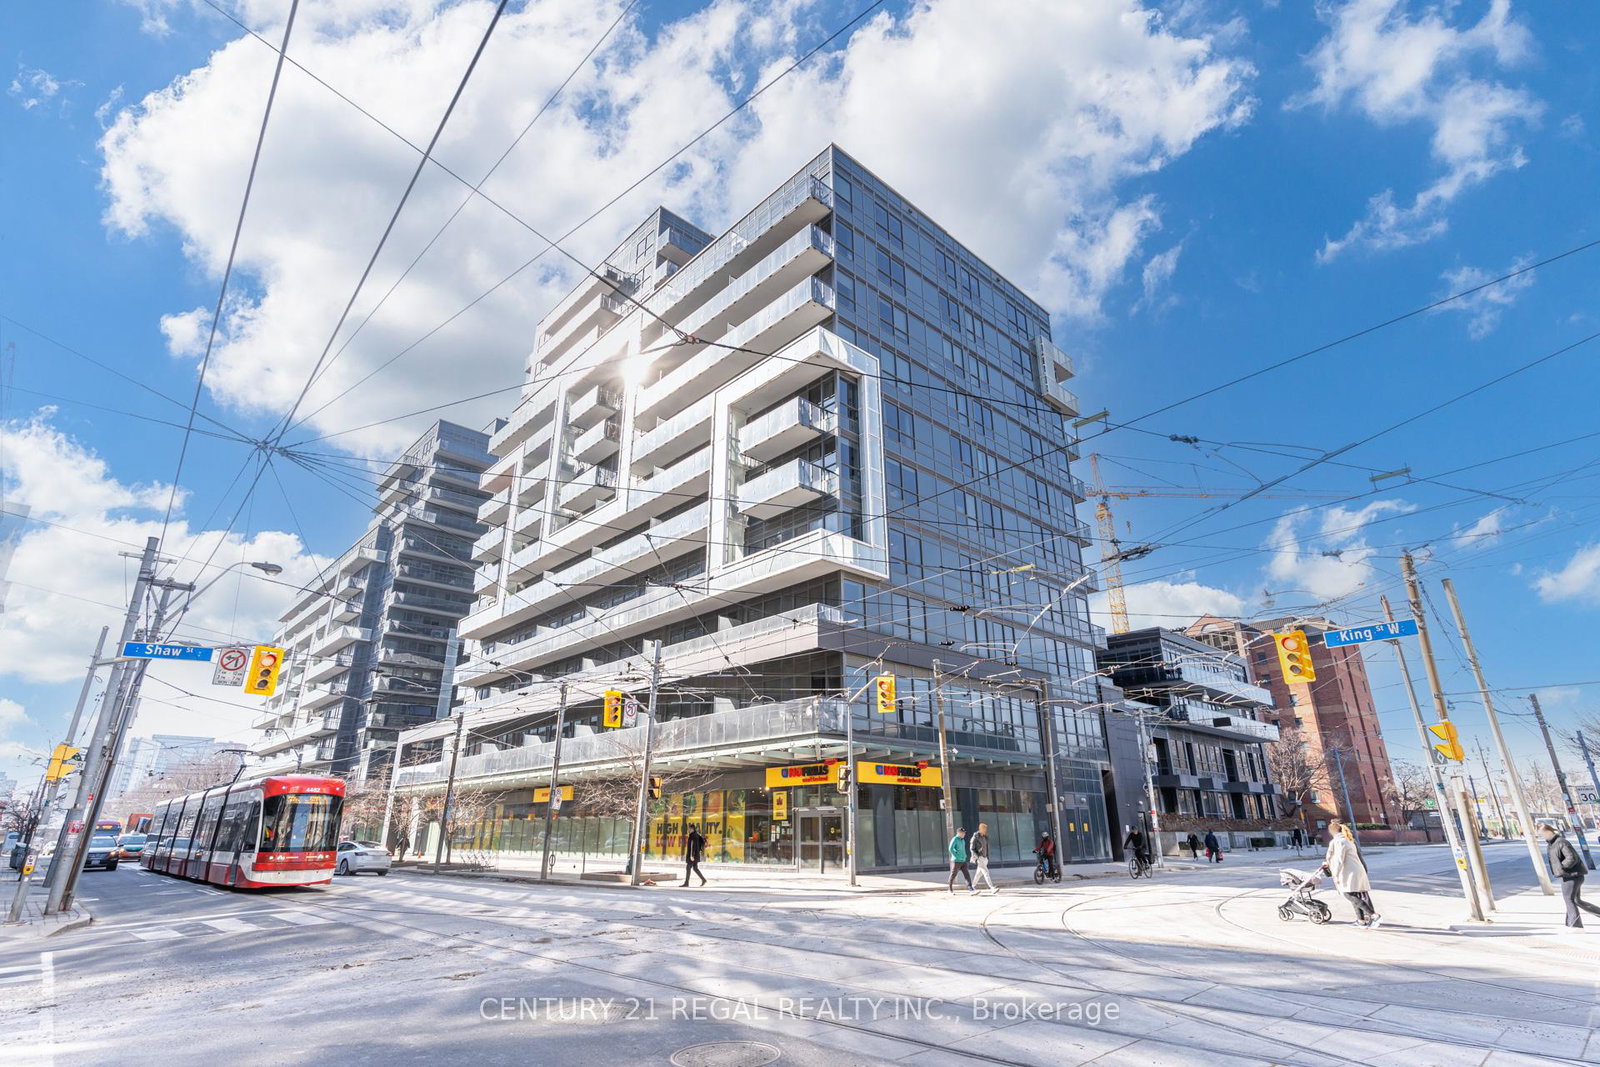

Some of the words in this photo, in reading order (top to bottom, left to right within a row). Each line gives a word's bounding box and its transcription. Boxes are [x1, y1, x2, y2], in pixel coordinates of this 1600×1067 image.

[1340, 629, 1373, 641] King
[1387, 622, 1400, 634] W
[145, 644, 182, 657] Shaw
[1580, 793, 1596, 802] 30
